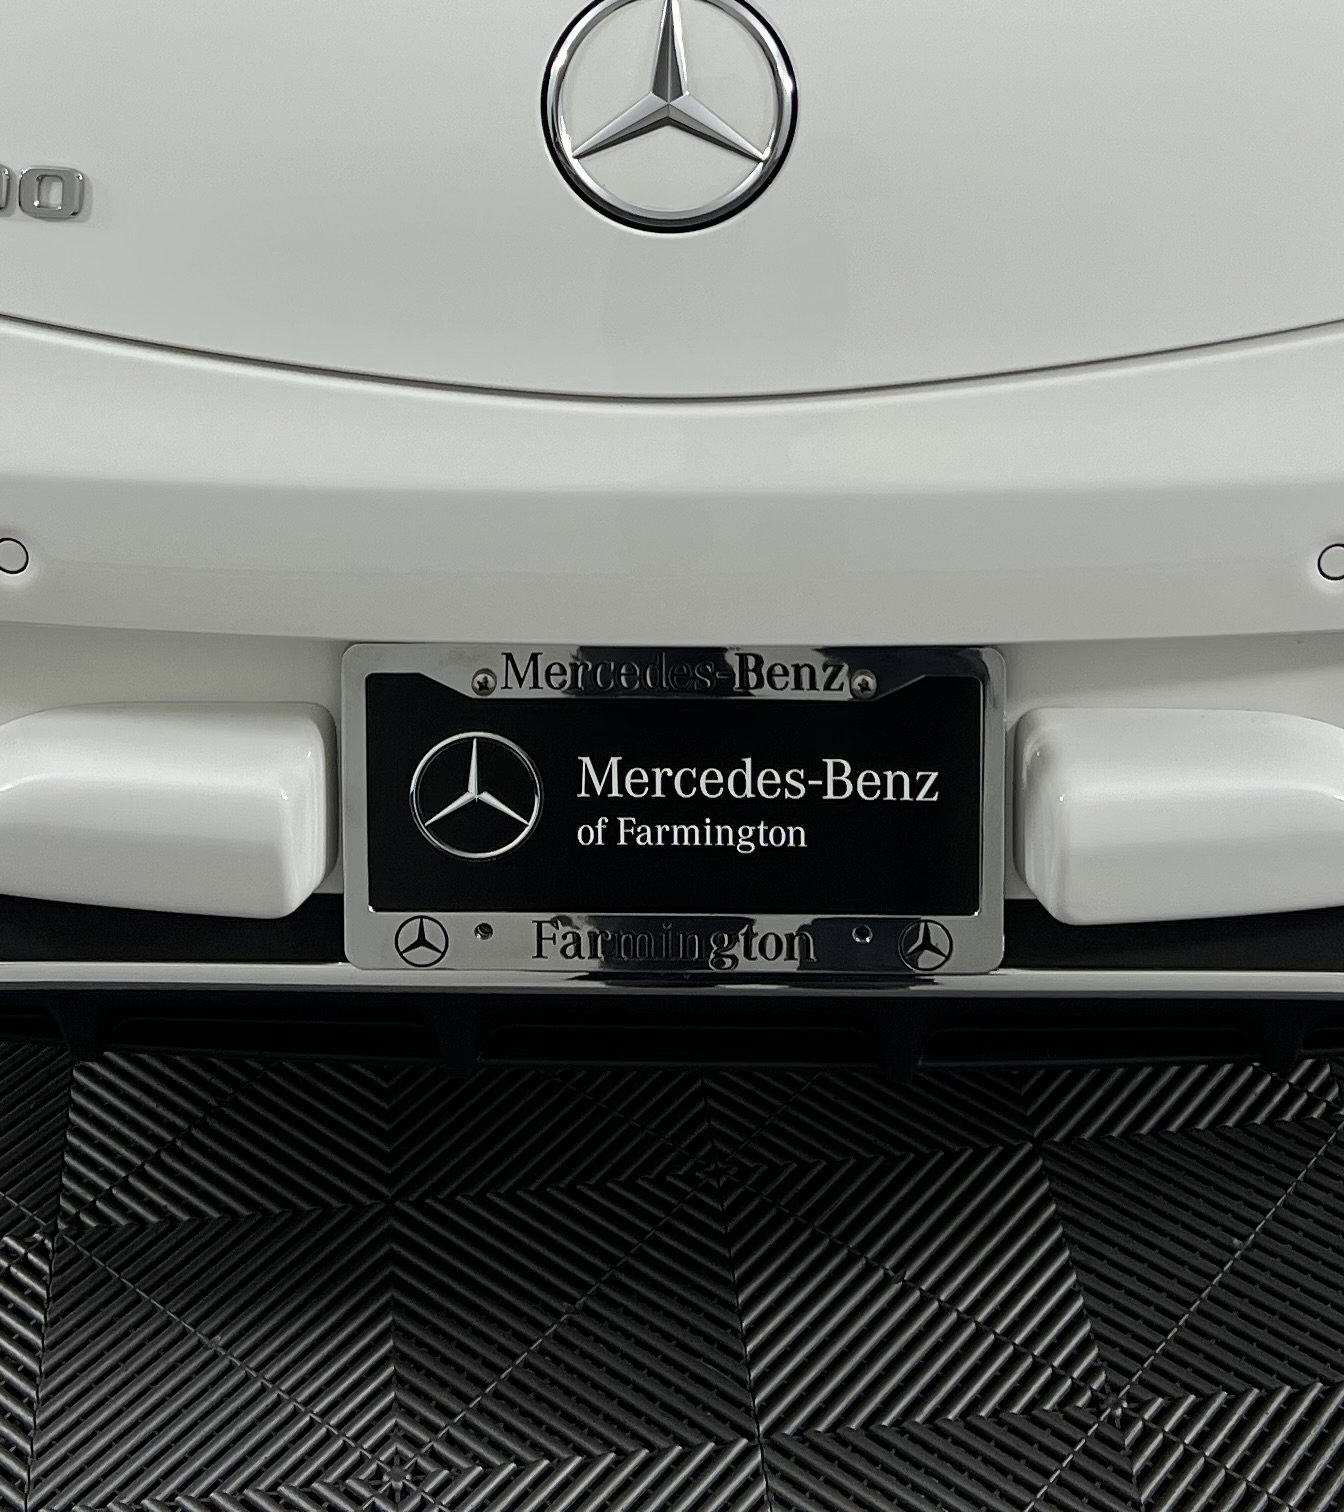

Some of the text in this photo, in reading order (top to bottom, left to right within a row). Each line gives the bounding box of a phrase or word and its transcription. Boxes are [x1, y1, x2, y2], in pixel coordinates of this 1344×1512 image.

[500, 651, 851, 693] Mercedes-Benz
[576, 756, 940, 802] Mercedes-Benz
[576, 816, 808, 854] of Farmington
[531, 918, 816, 971] Farmington
